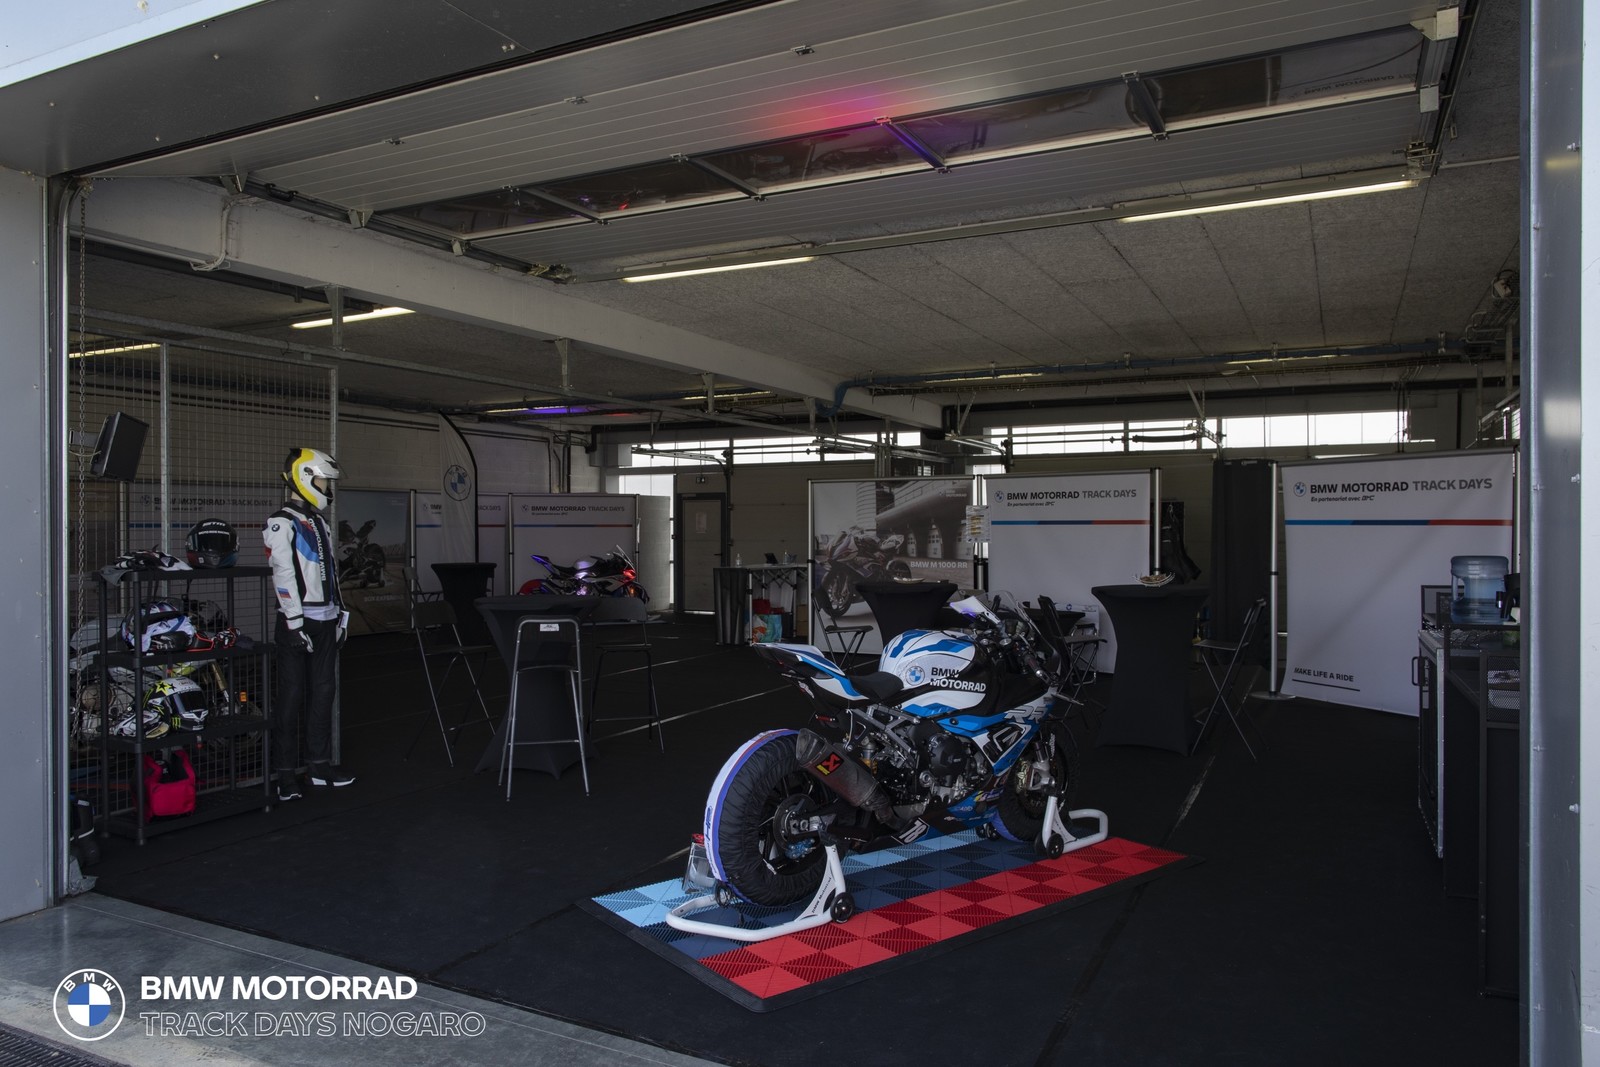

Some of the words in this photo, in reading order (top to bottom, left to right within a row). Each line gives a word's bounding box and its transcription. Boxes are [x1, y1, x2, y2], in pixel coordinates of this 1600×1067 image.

[1310, 484, 1338, 494] BMW
[1341, 482, 1409, 493] MOTORRAD
[1412, 480, 1457, 491] TRACK
[1458, 478, 1493, 490] DAYS
[154, 497, 176, 506] BW
[1007, 492, 1028, 500] BMW
[1030, 491, 1079, 500] MOTORRAD
[1082, 490, 1112, 498] TRACK
[1113, 489, 1137, 498] DAYS
[1318, 495, 1348, 503] partenariat
[308, 518, 324, 560] MOTORRAD
[319, 561, 327, 581] BMW
[957, 561, 968, 569] RR
[931, 667, 960, 678] BMW
[1294, 667, 1312, 676] MAKE
[1313, 670, 1328, 679] LIFE
[1329, 672, 1335, 680] A
[1336, 673, 1354, 682] RIDE
[930, 678, 987, 692] MOTORRAD
[1004, 705, 1049, 725] RR
